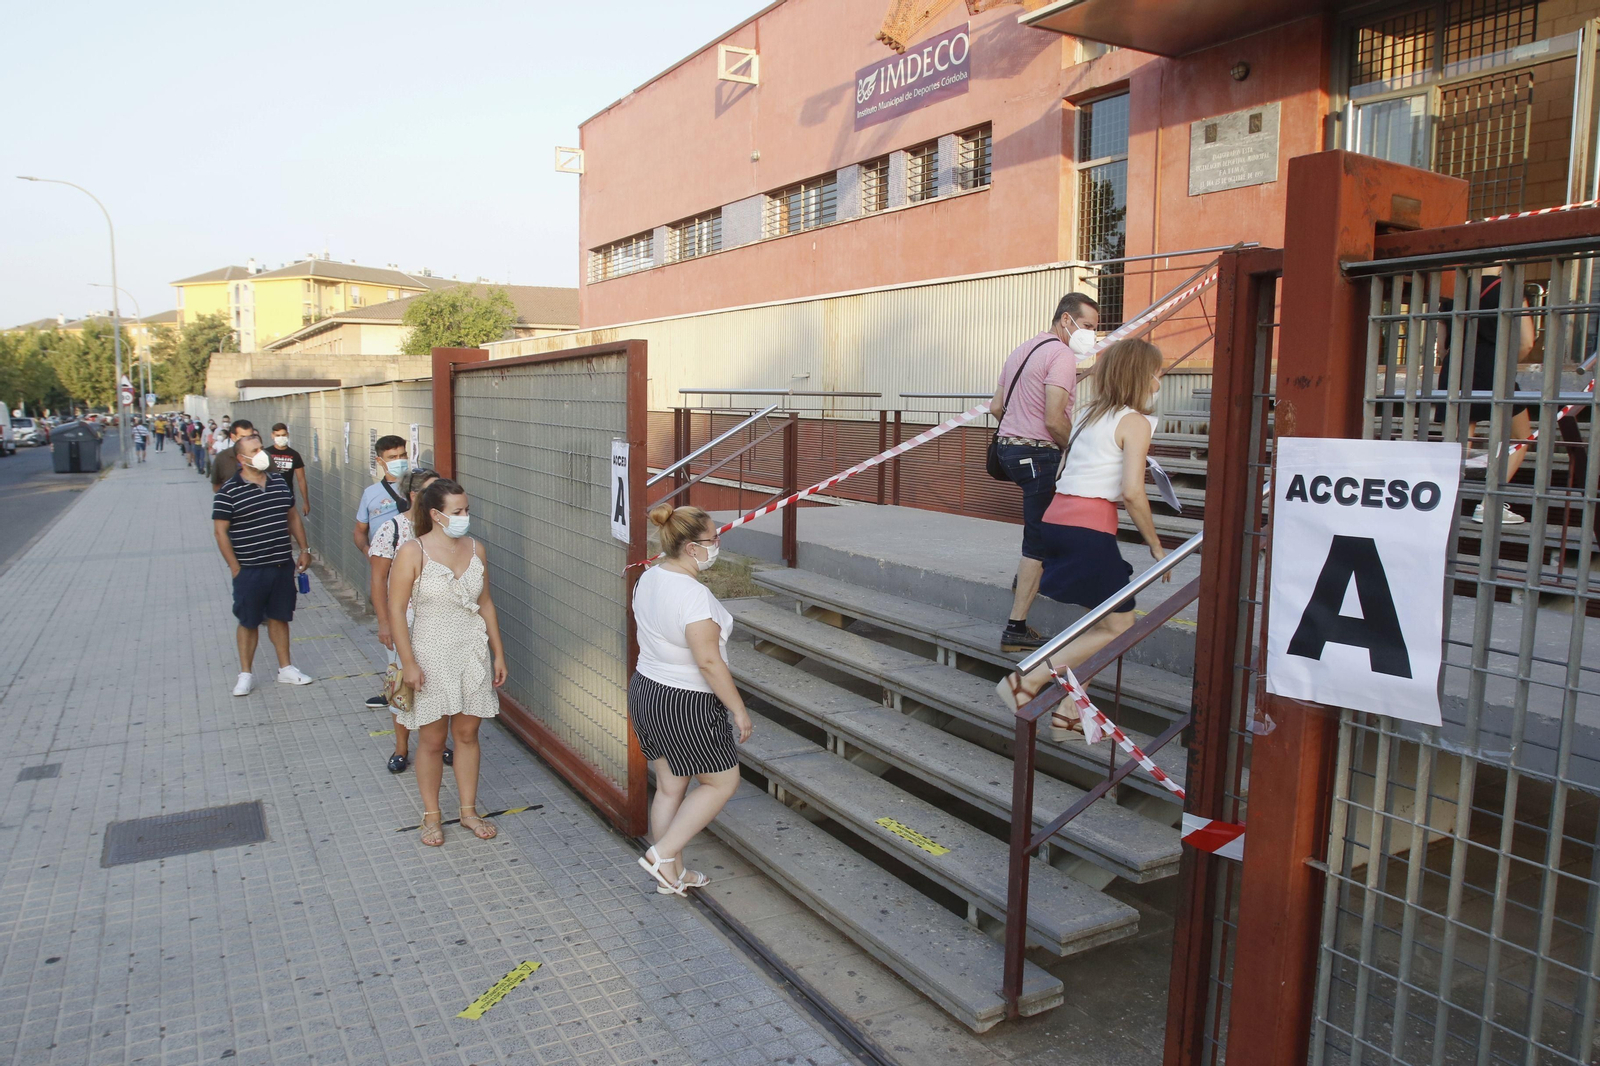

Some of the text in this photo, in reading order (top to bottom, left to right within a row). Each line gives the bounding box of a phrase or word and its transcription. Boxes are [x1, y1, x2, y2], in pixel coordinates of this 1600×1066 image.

[880, 33, 969, 94] IMDECO
[857, 71, 968, 119] Instituto Municipal de Deportes Córdoba
[614, 477, 626, 526] A
[1285, 474, 1442, 512] ACCESO
[1286, 535, 1413, 679] A
